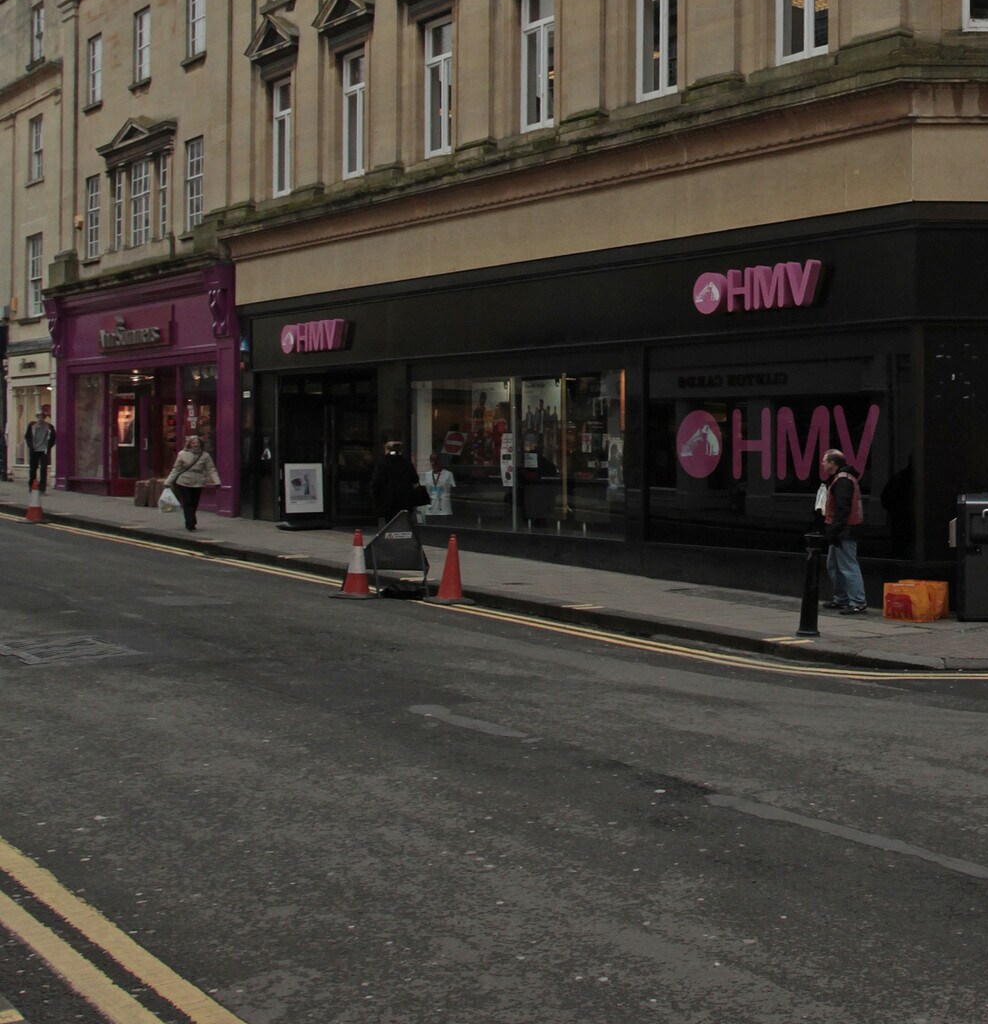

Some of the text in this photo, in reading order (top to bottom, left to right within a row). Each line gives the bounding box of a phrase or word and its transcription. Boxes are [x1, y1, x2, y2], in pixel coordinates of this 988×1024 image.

[727, 259, 822, 313] HMV
[296, 318, 344, 353] HMV
[732, 403, 880, 481] HMV
